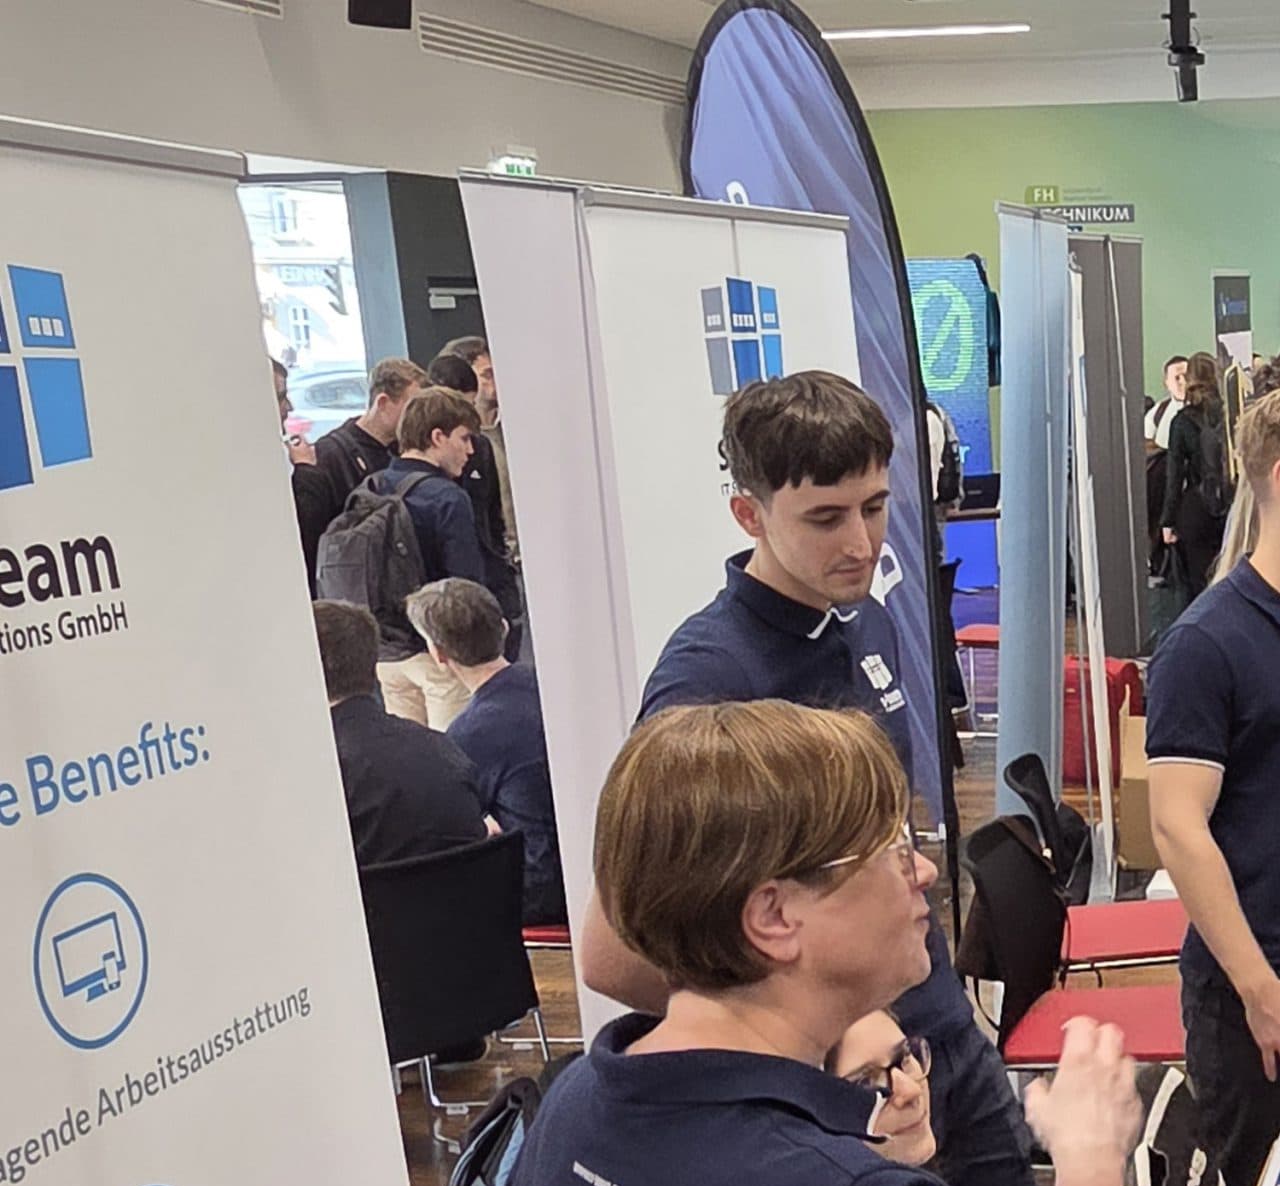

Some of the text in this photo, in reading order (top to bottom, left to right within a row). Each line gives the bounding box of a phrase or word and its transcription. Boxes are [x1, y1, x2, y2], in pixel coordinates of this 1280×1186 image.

[1034, 188, 1055, 203] FH
[58, 601, 128, 640] GmbH
[26, 722, 209, 816] Benefits:
[98, 987, 311, 1126] Arbeitsausstattung
